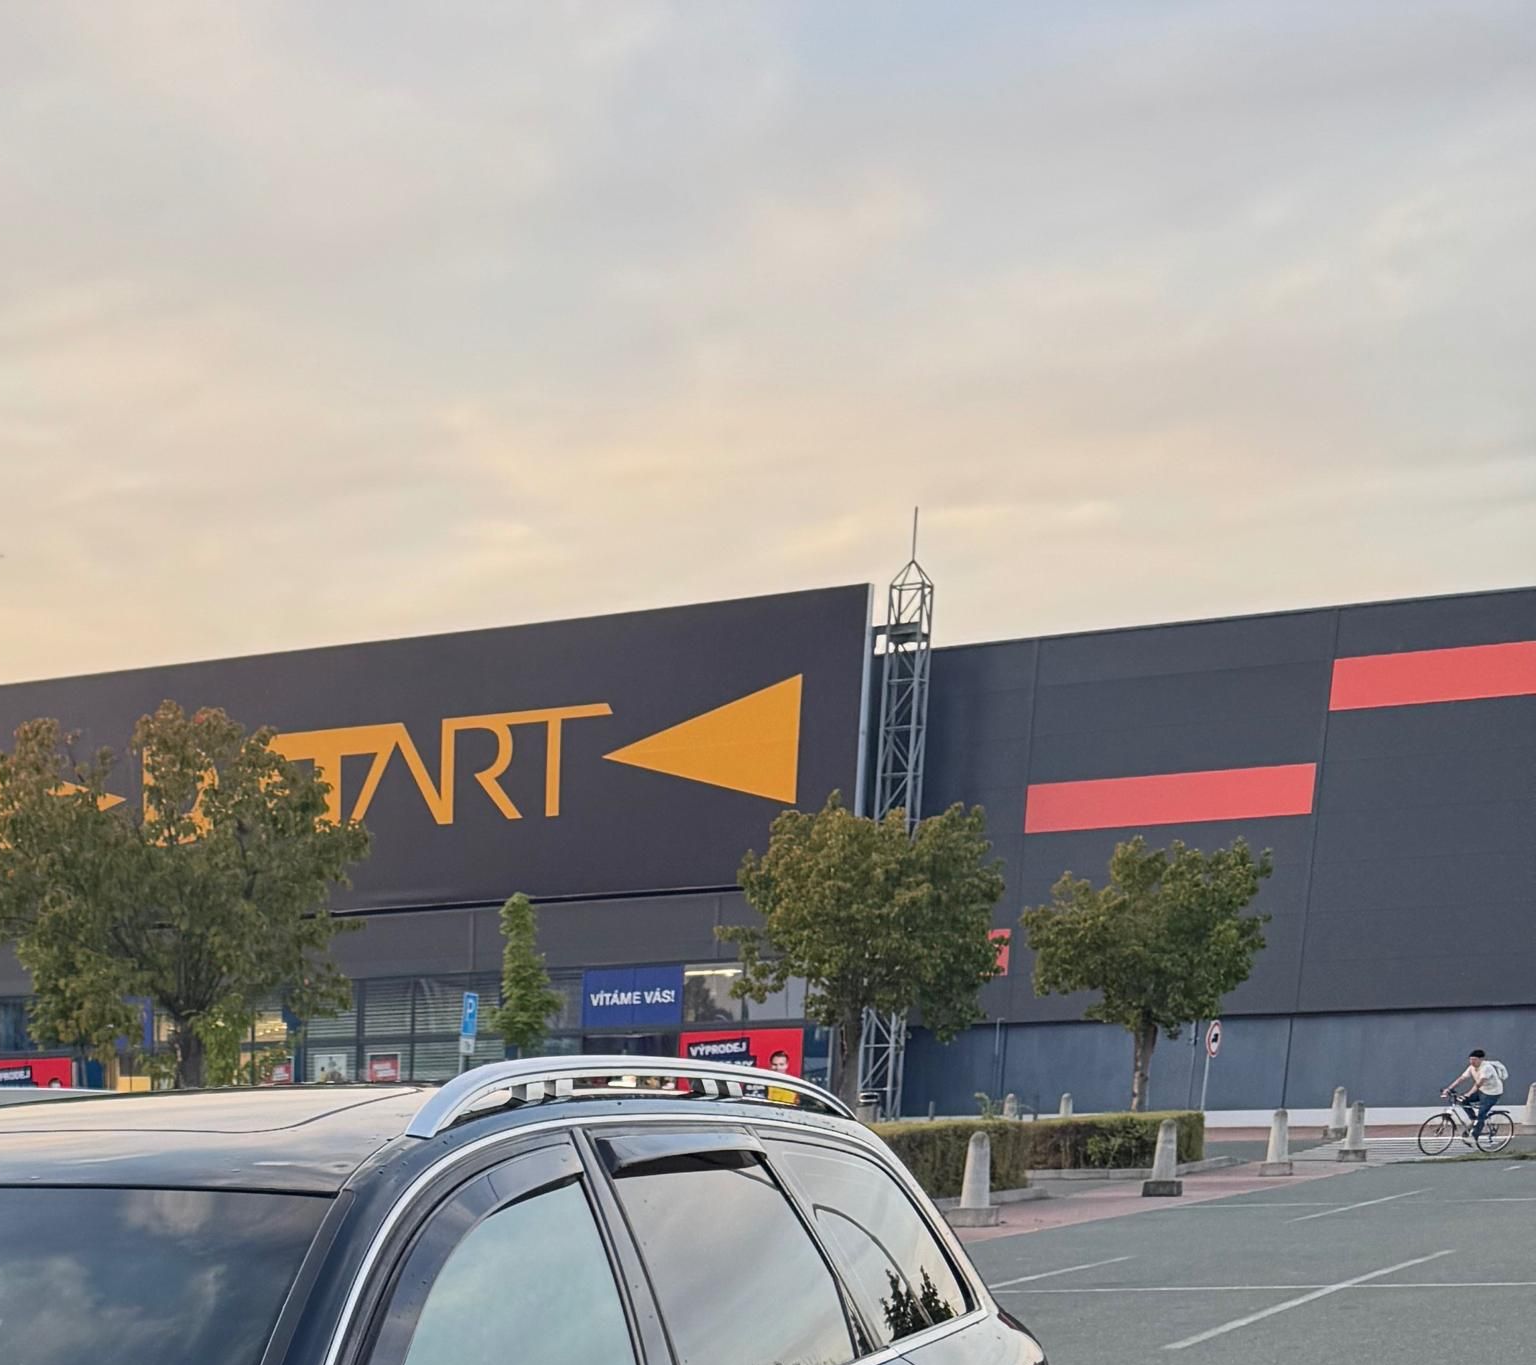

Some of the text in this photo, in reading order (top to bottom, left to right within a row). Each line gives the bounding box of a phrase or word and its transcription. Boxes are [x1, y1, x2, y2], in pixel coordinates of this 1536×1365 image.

[143, 702, 613, 847] TART
[590, 987, 675, 1007] VÍTÁME VÁS!
[689, 1042, 747, 1057] VÝPRODEJ
